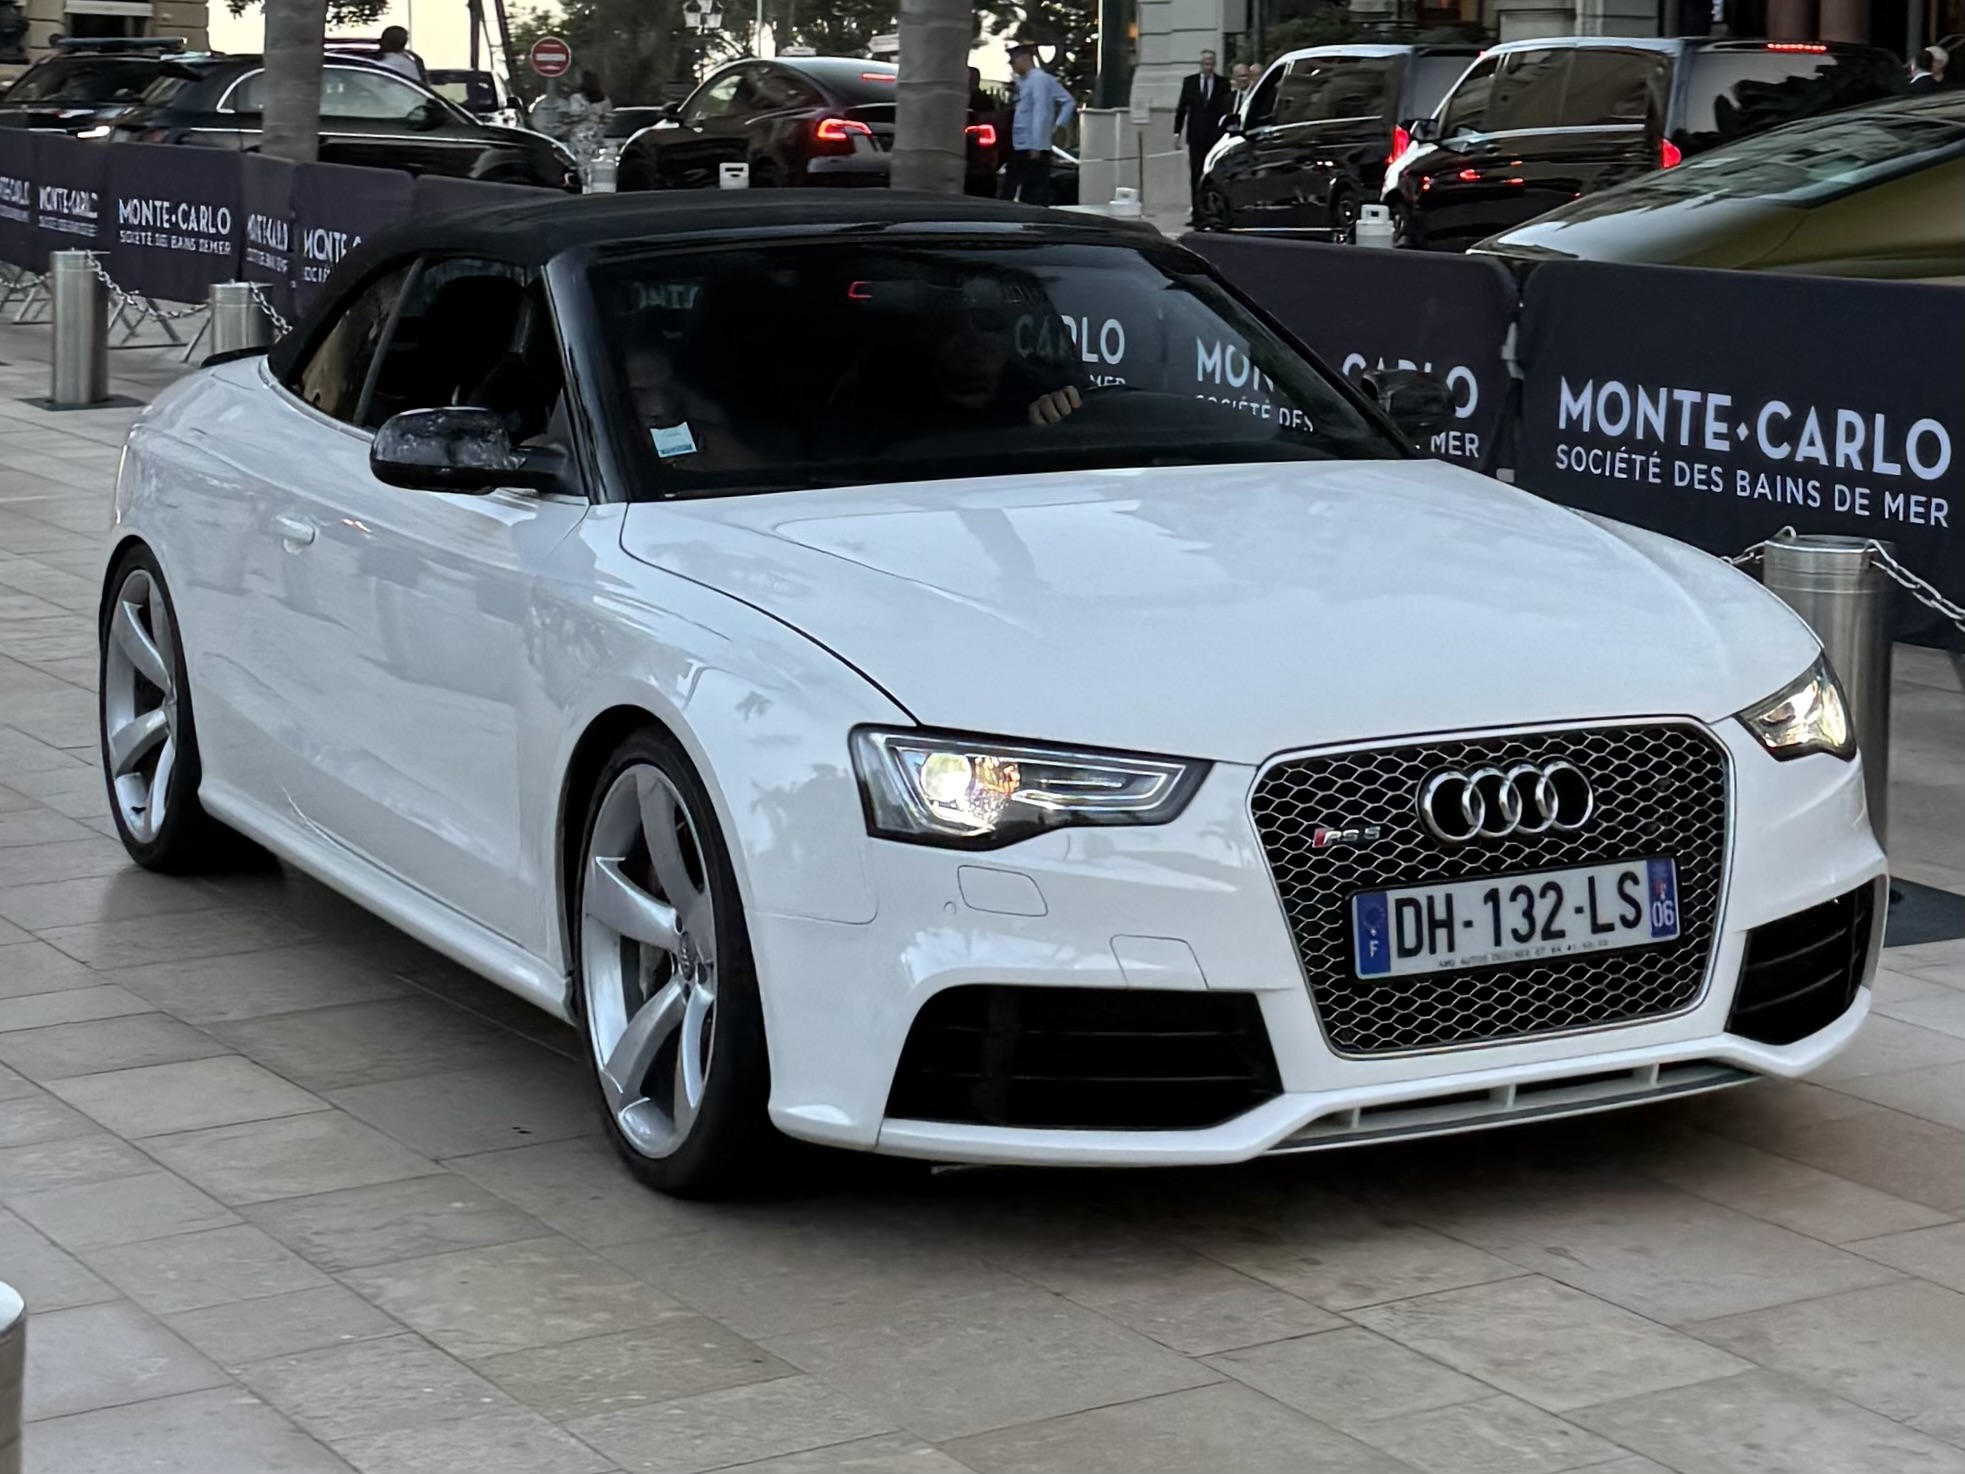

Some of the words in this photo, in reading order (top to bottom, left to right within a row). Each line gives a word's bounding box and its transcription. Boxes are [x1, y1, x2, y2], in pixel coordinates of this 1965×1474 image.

[1431, 430, 1480, 458] MER
[1555, 444, 1662, 484] SOCIÉTÉ
[1674, 460, 1724, 493] DES
[1736, 469, 1821, 508] BAINS
[1834, 484, 1871, 516] DE
[1884, 491, 1949, 528] MER
[1394, 870, 1643, 959] DH-132-LS
[1652, 900, 1675, 928] 06
